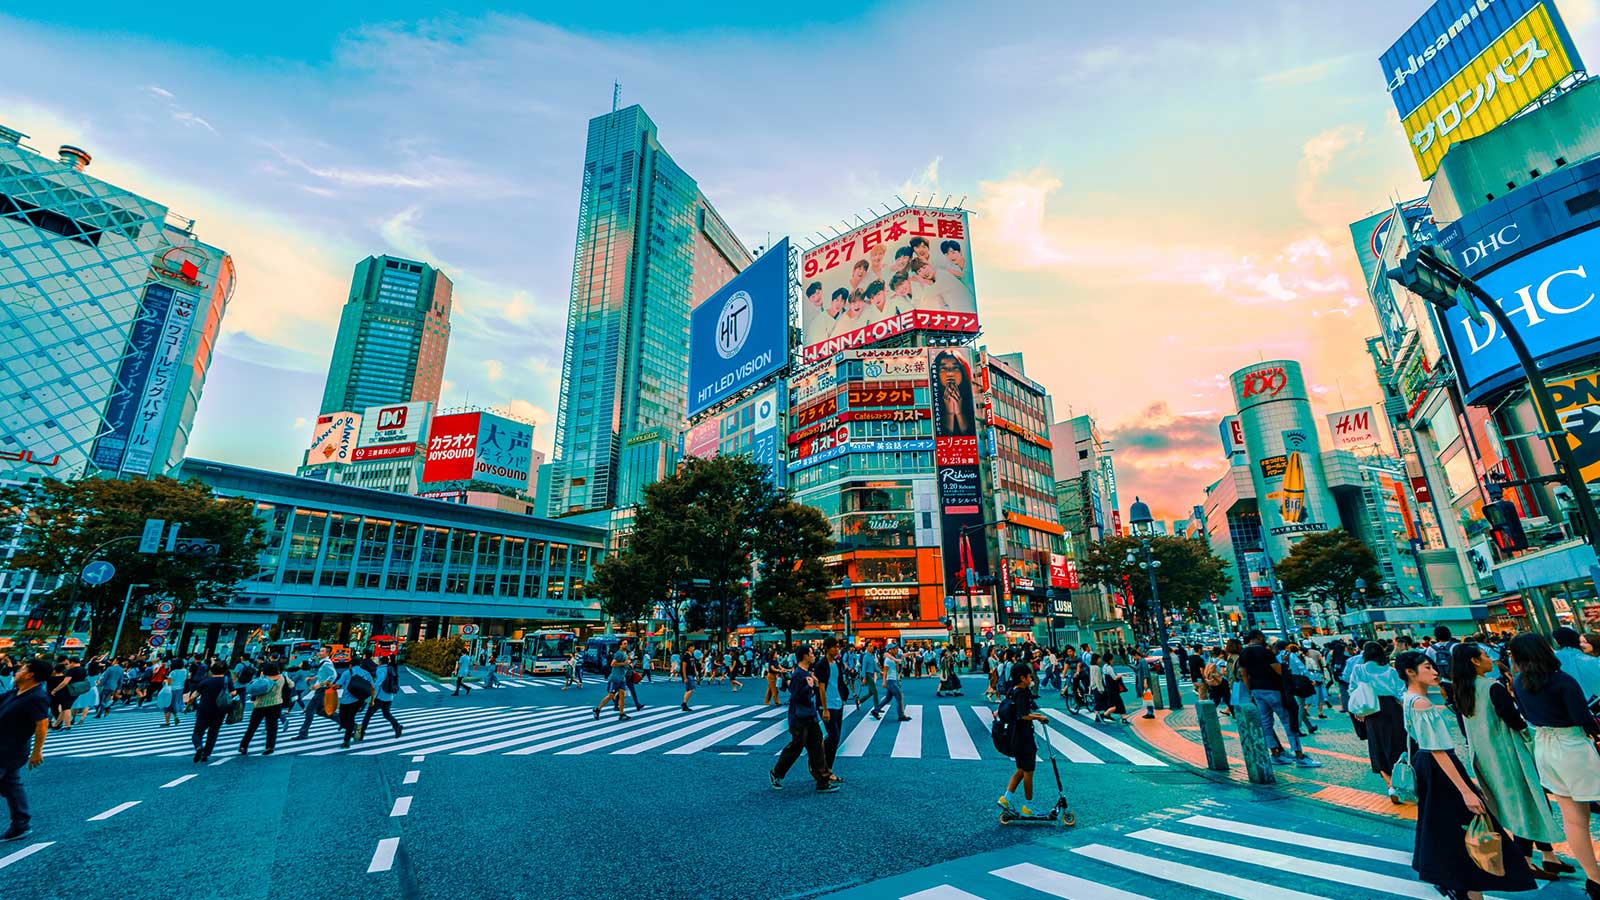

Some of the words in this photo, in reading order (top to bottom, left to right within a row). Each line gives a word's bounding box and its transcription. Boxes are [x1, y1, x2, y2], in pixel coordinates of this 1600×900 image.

[1412, 36, 1549, 154] サロンパス
[804, 240, 856, 279] 9.27
[863, 217, 965, 254] 日本上陸
[1461, 222, 1521, 268] DHC
[1460, 264, 1595, 356] DHC
[917, 313, 976, 328] ワナワン
[698, 383, 714, 403] HIT
[714, 372, 735, 394] LED
[736, 349, 772, 382] VISION
[1241, 371, 1288, 398] 109
[849, 390, 912, 403] コンタクト
[379, 408, 404, 428] DC
[800, 399, 836, 424] プライス
[893, 410, 924, 421] ガスト
[820, 417, 840, 432] ガスト
[1335, 411, 1369, 434] H&M
[311, 418, 344, 450] SANKYO
[339, 416, 356, 459] SANKYO
[430, 433, 477, 450] カラオケ
[480, 423, 531, 451] 大声
[937, 437, 976, 448] ユリゴコロ
[1342, 435, 1364, 443] 150m
[790, 448, 798, 459] 7F
[811, 435, 834, 455] ガスト
[877, 441, 934, 450] 英会話イーオン
[428, 448, 475, 461] JOYSOUND
[475, 461, 527, 480] JOYSOUND
[940, 468, 978, 482] Rihwa
[1270, 525, 1327, 535] MAYBELLINE
[864, 587, 910, 596] L'OCCITANE
[1054, 600, 1073, 613] LUSH
